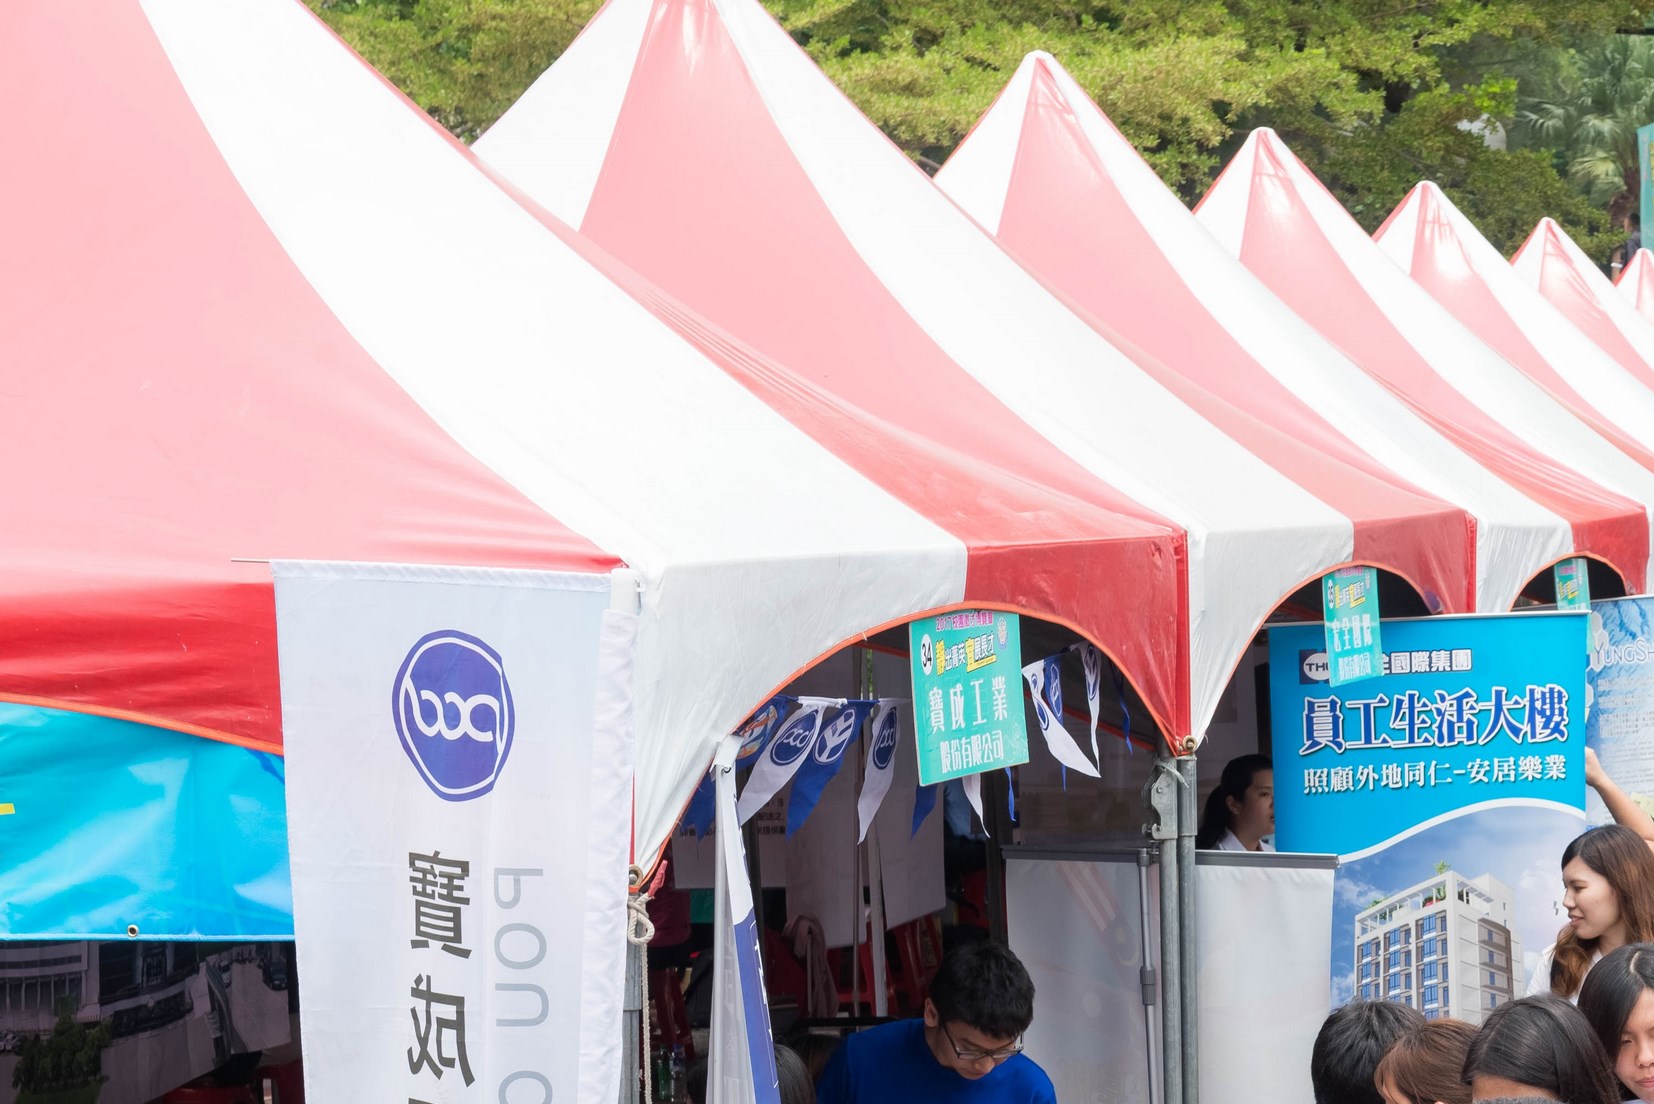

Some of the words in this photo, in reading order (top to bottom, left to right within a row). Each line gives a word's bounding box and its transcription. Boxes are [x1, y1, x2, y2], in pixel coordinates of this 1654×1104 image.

[922, 643, 932, 668] 34
[929, 676, 1008, 734] 寶成工業
[1299, 684, 1569, 756] 員工生活大樓
[940, 730, 1004, 774] 股份有限公司
[1303, 754, 1567, 795] 照顧外地同仁-安居樂業
